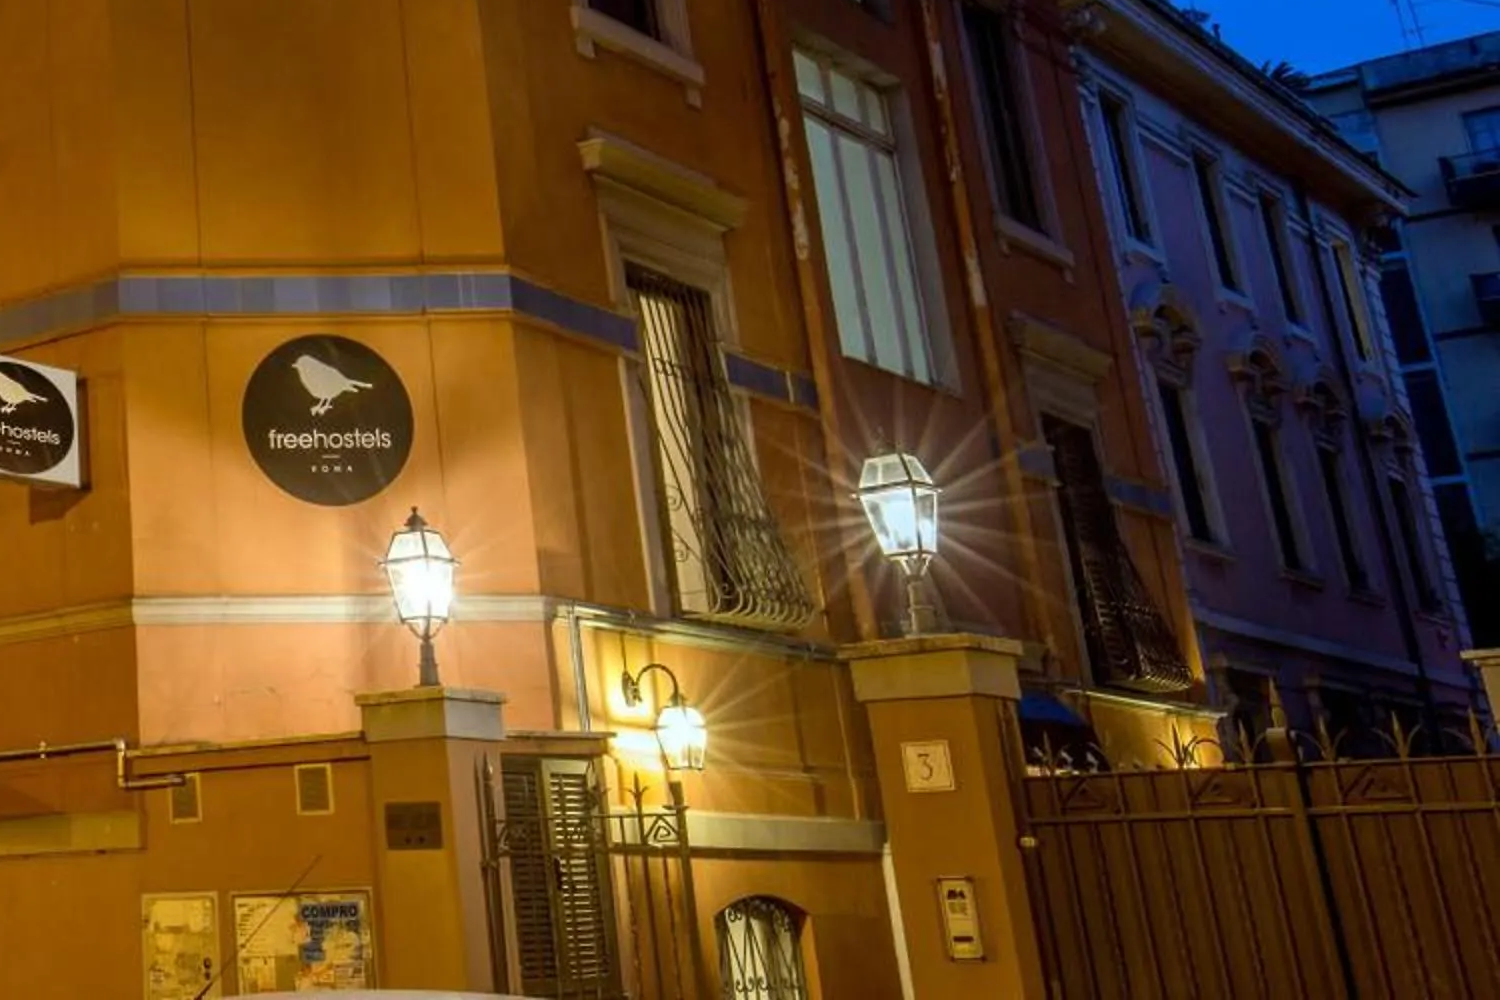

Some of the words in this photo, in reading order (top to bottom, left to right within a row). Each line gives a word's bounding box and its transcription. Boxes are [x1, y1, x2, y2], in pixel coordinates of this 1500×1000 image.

[268, 427, 391, 449] freehostels
[917, 753, 933, 781] 3
[301, 903, 358, 919] COMPRO
